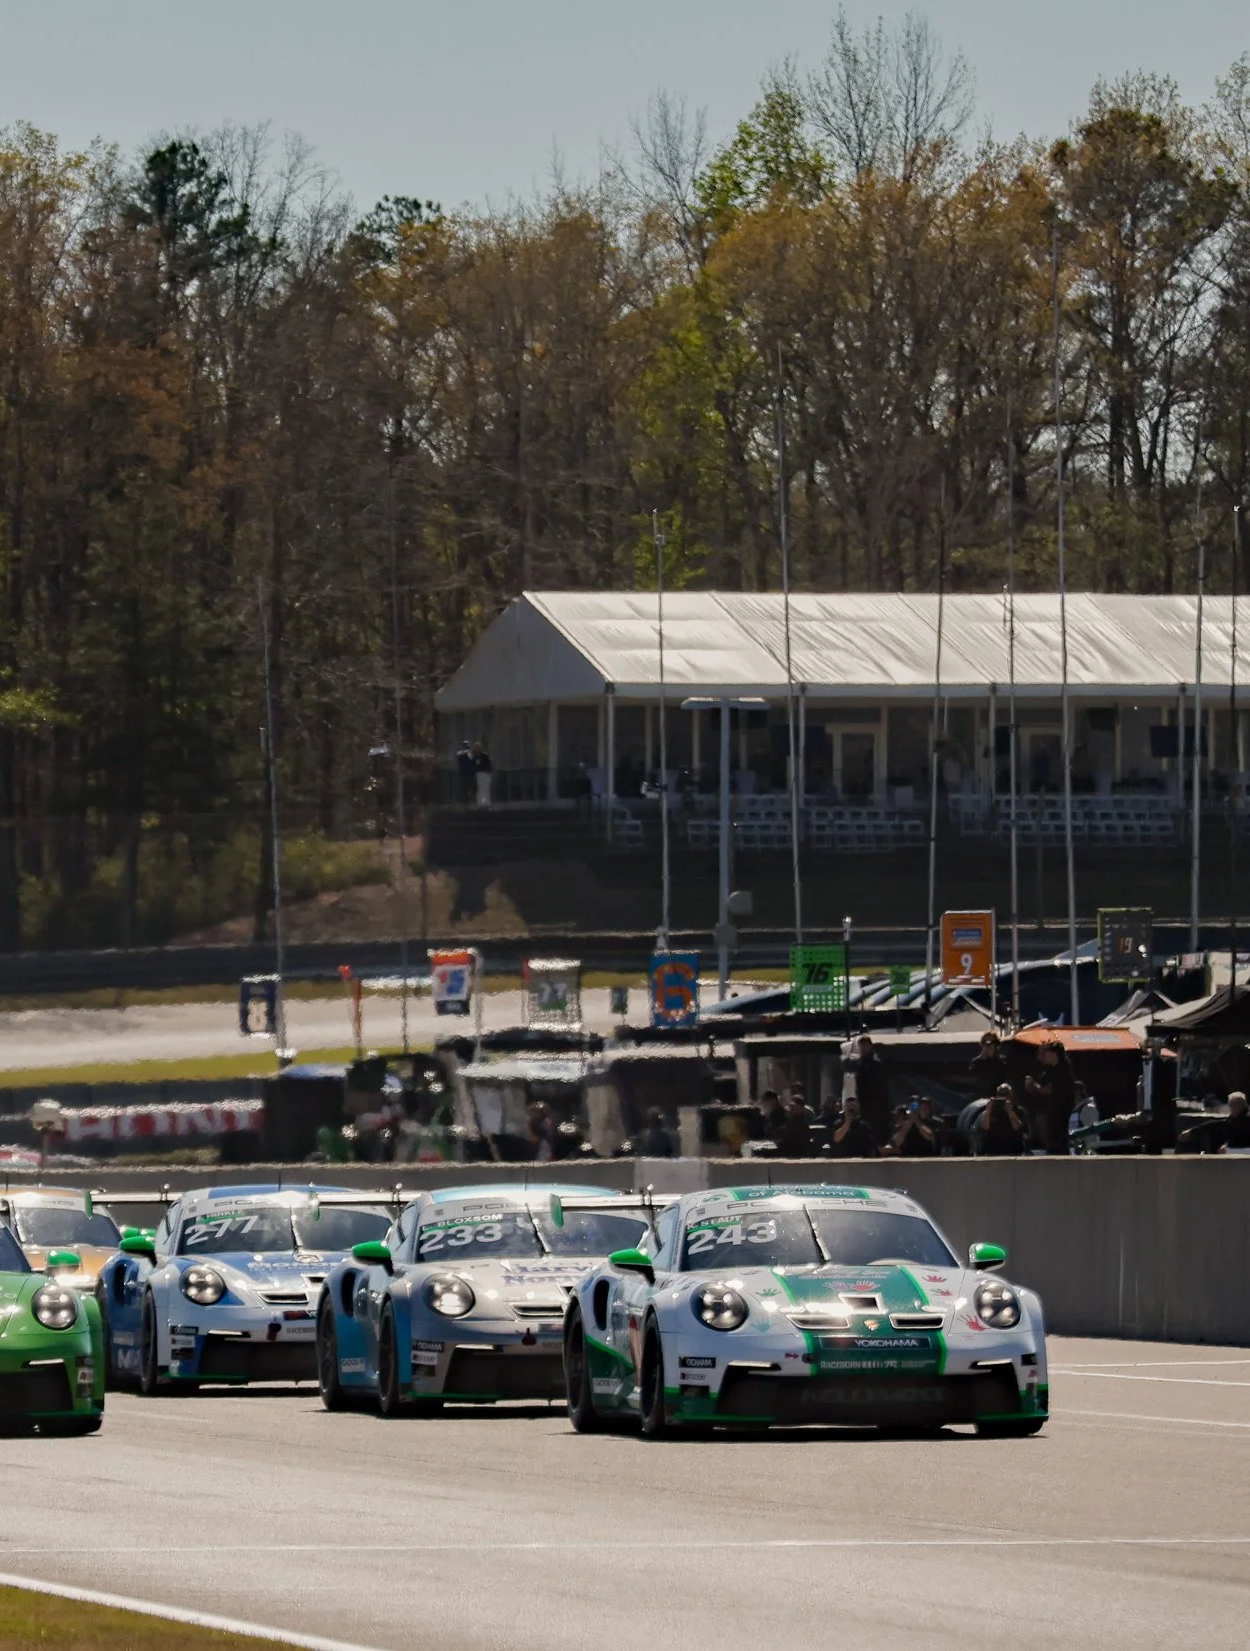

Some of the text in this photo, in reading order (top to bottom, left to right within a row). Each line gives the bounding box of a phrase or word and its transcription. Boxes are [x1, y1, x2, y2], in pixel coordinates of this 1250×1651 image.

[960, 953, 973, 976] 9
[652, 962, 695, 1020] 6
[184, 1215, 259, 1246] 277
[437, 1213, 504, 1228] BLOXSOM
[419, 1222, 502, 1254] 233
[687, 1221, 777, 1256] 243
[854, 1338, 919, 1348] YOKOHAMA
